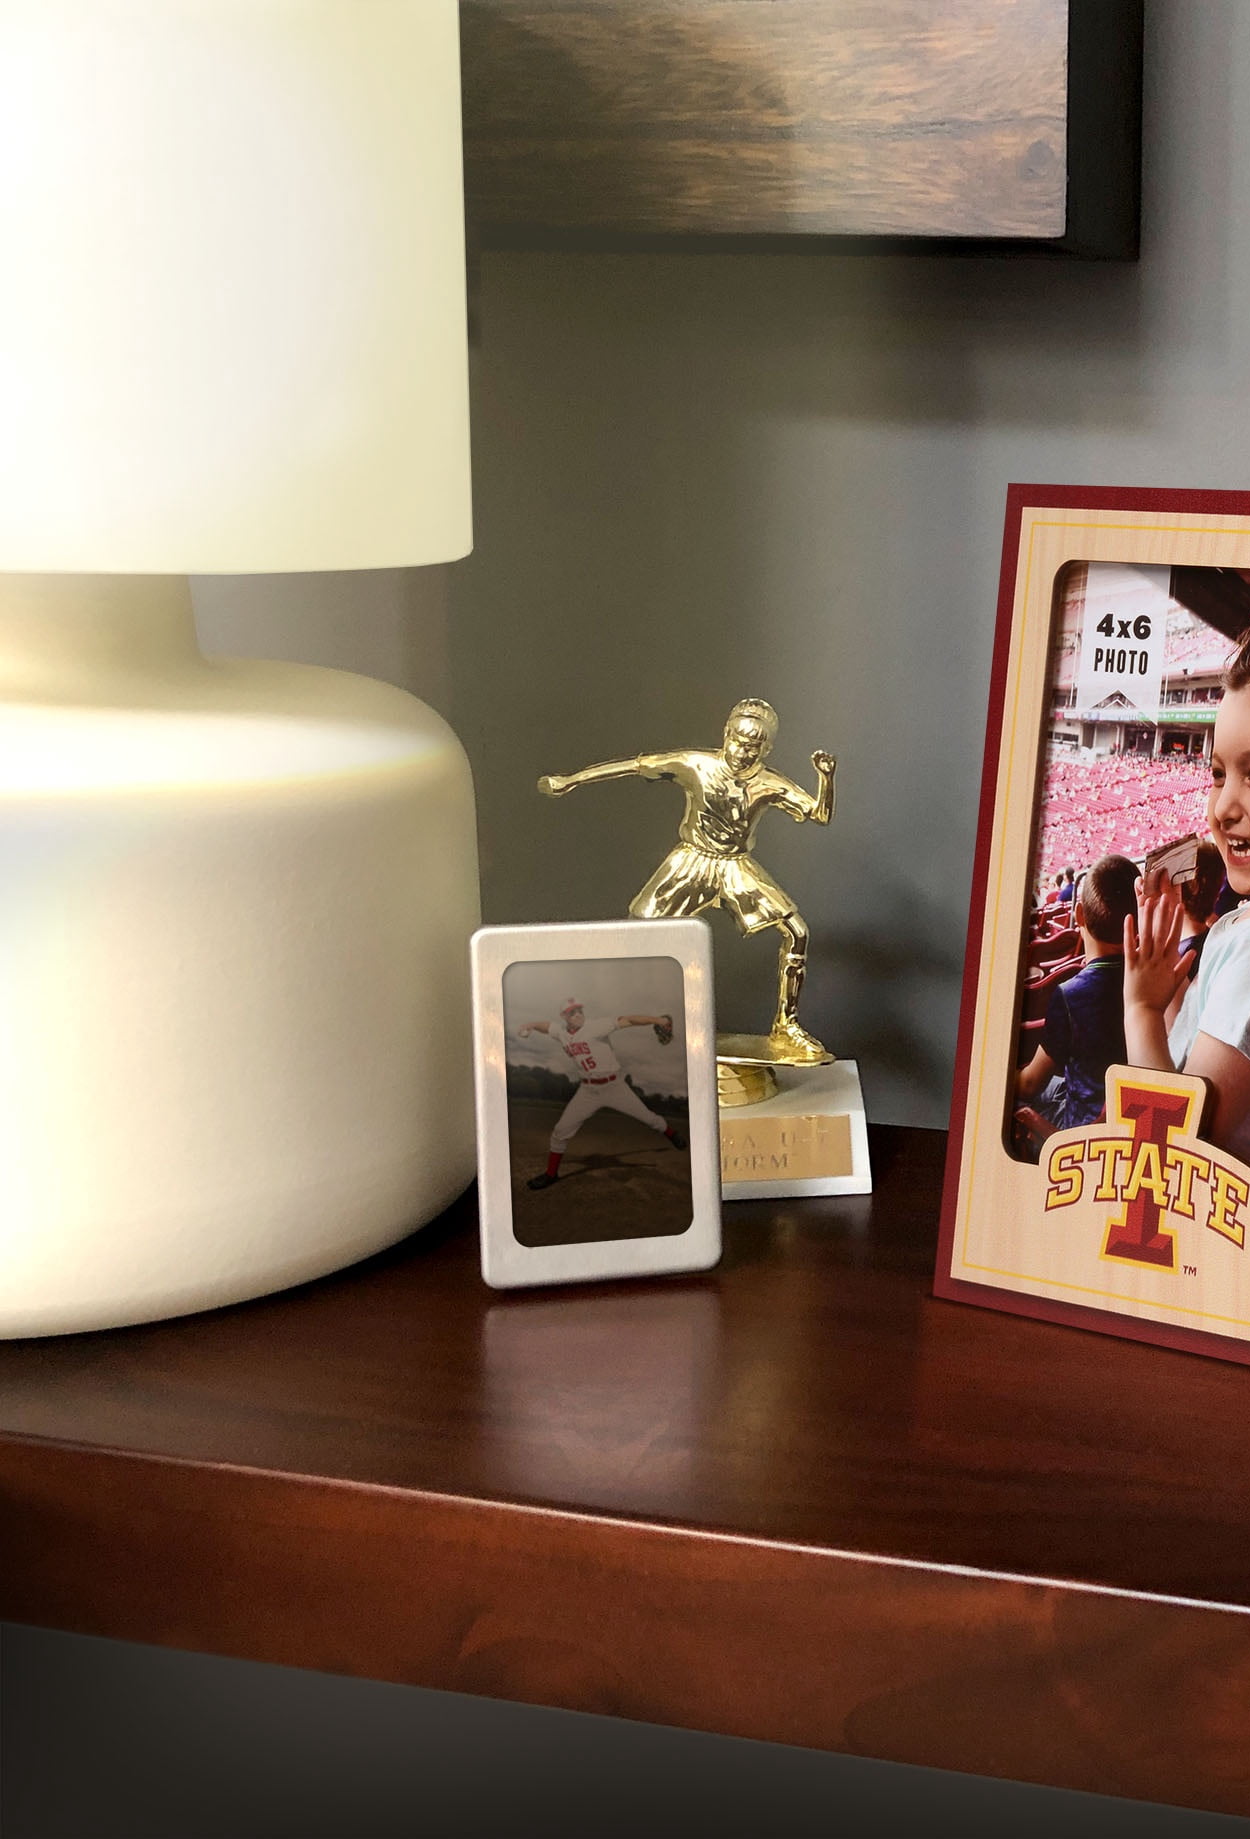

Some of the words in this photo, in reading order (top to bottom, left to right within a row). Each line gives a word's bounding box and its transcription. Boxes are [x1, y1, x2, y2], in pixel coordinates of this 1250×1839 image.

[1096, 613, 1152, 640] 4x6
[1093, 647, 1149, 676] PHOTO
[1045, 1136, 1250, 1250] STATE
[1182, 1265, 1198, 1277] TM
